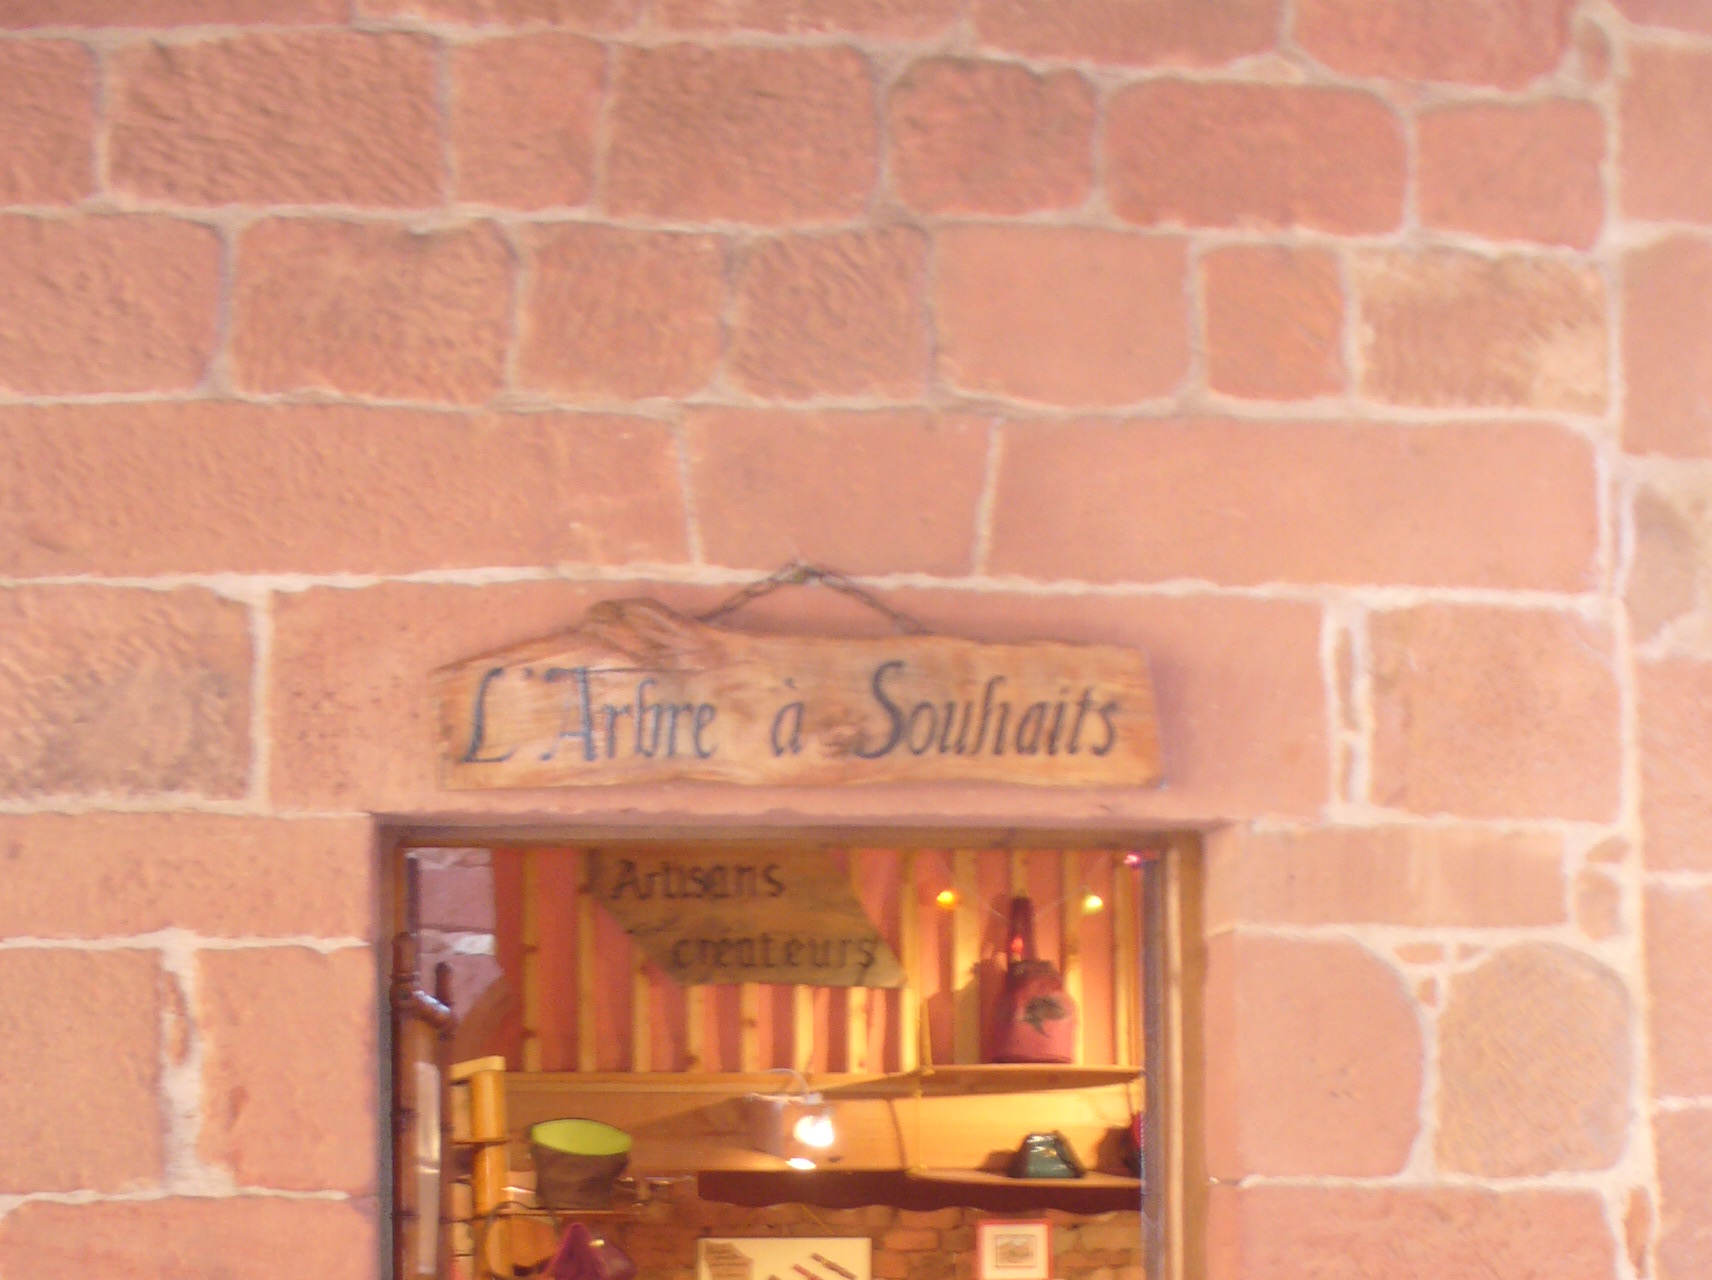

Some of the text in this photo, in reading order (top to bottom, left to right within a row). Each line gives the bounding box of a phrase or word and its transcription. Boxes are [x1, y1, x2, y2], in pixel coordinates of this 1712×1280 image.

[459, 659, 1119, 764] L'Arbre à Souhaits
[610, 859, 785, 900] Artisans
